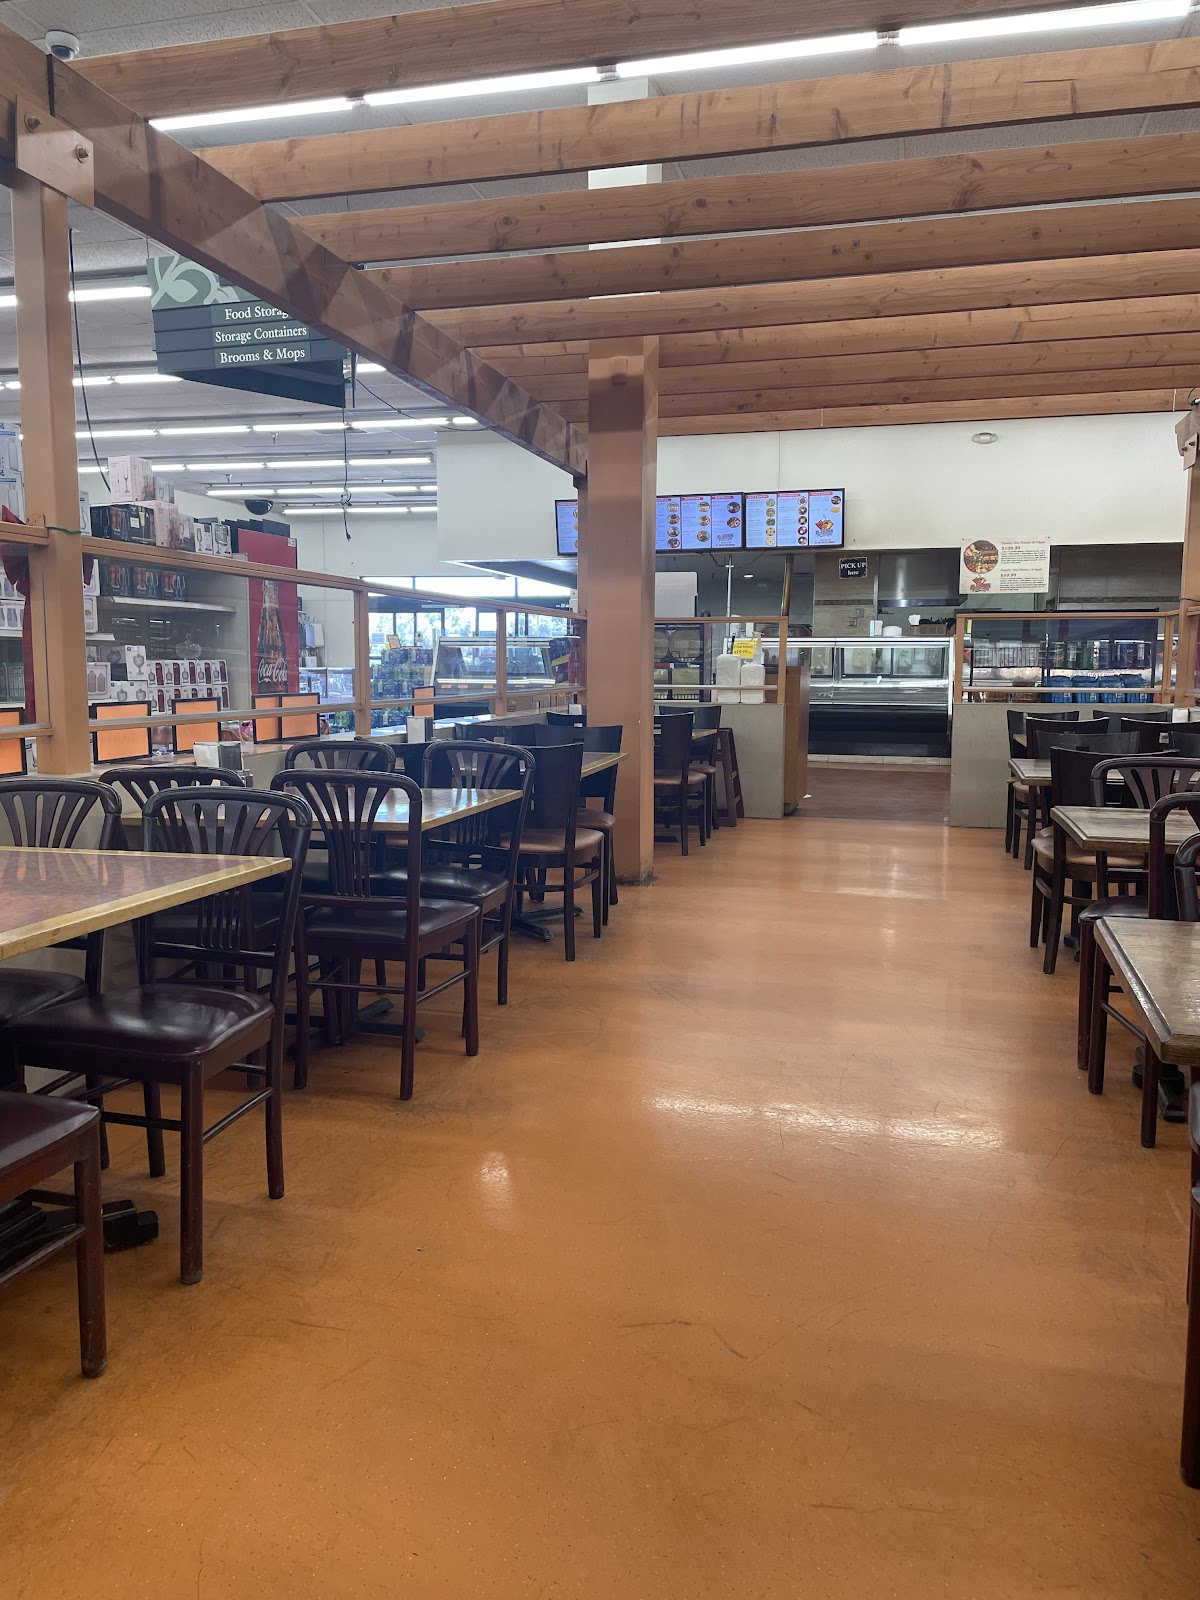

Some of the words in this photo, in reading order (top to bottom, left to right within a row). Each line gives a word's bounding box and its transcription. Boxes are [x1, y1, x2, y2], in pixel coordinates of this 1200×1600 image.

[224, 307, 252, 320] Food
[254, 306, 289, 319] Storag
[215, 331, 252, 344] Storage
[254, 325, 307, 339] Containers
[220, 352, 260, 364] Brooms
[263, 348, 274, 360] &
[276, 347, 306, 362] Mops
